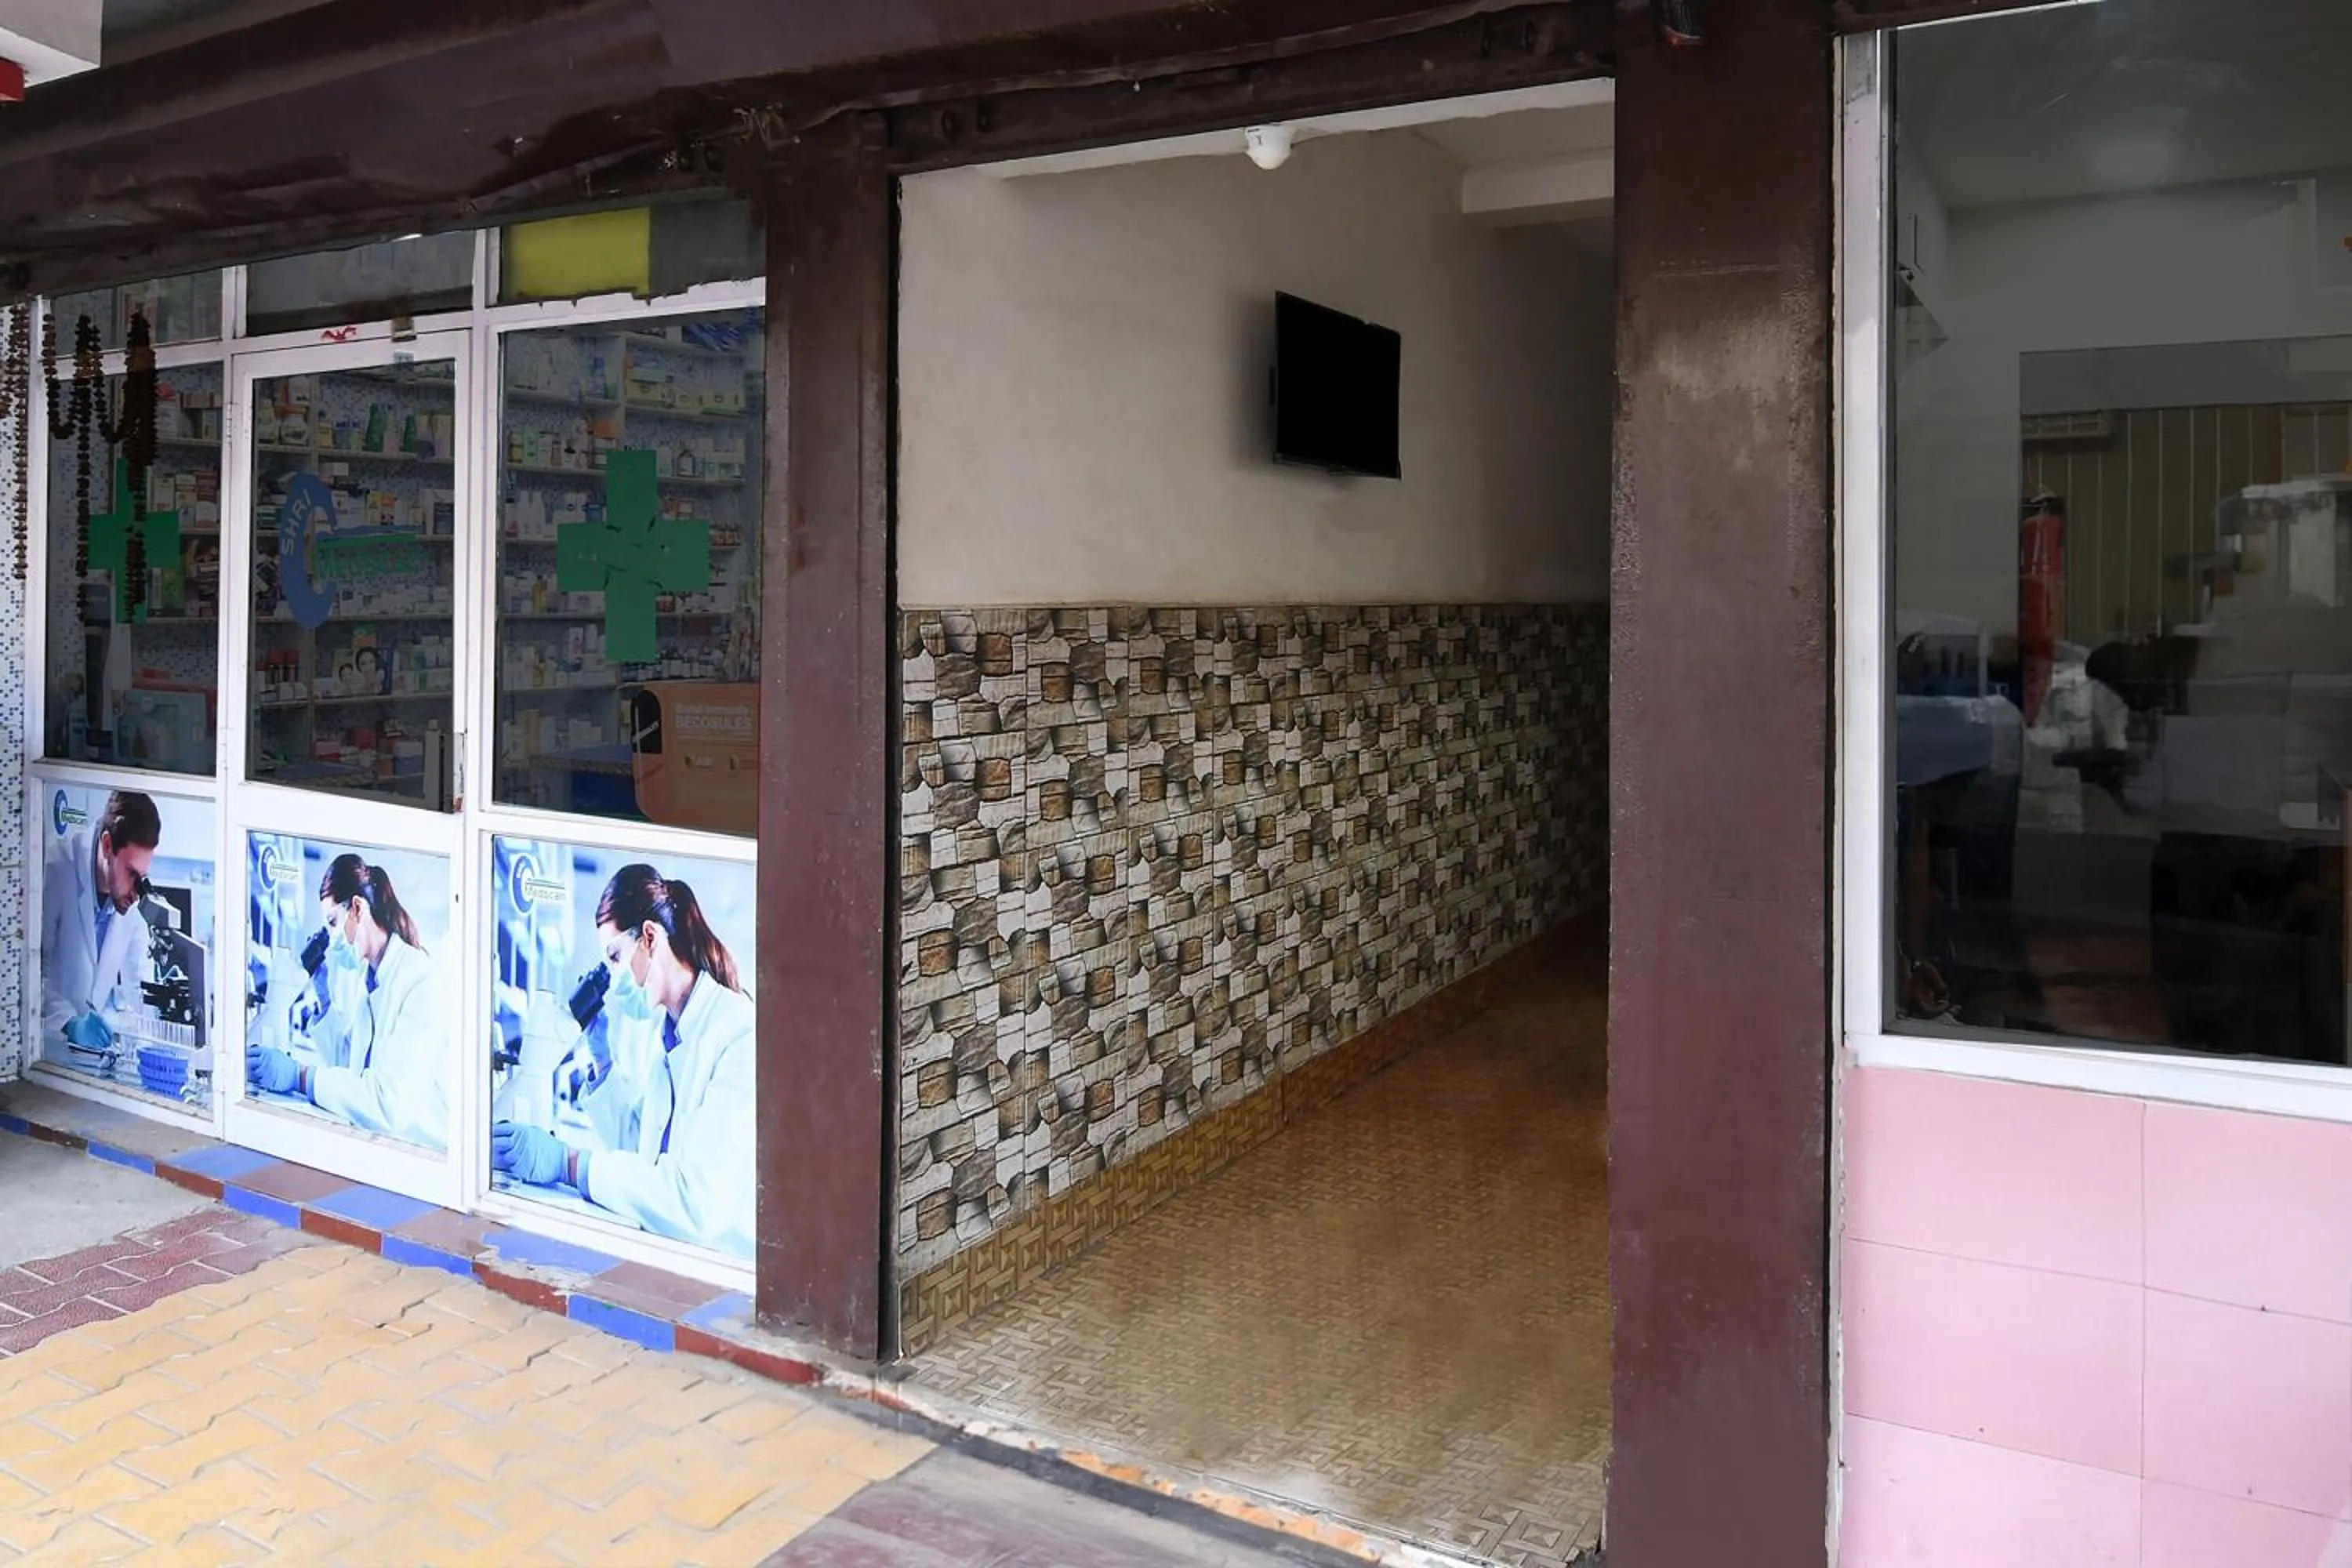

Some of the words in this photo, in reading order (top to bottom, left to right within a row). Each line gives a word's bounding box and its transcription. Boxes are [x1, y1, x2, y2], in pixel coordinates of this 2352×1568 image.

[281, 488, 312, 556] SHRI
[675, 714, 753, 731] BECOSULES
[524, 883, 566, 902] Medscan
